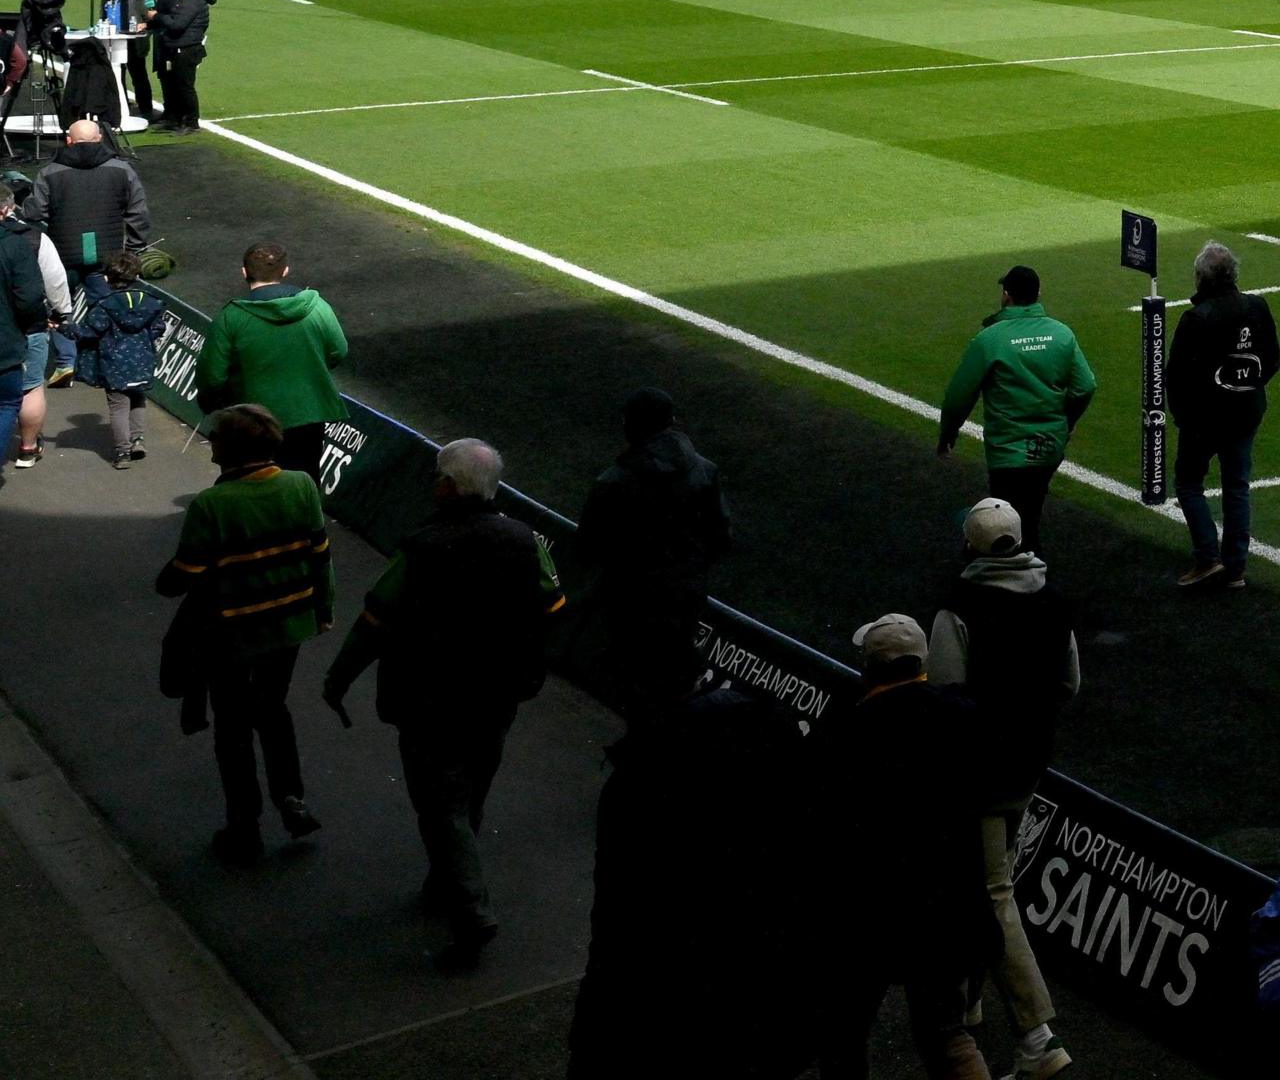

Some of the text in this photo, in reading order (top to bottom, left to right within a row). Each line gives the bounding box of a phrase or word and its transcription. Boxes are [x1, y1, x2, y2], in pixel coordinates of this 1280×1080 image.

[1152, 314, 1162, 484] Investec CHAMPIONS CUP
[1236, 367, 1250, 380] TV
[708, 636, 831, 719] NORTHAMPTON
[1026, 857, 1210, 1006] SAINTS
[1056, 817, 1228, 932] NORTHAMPTON
